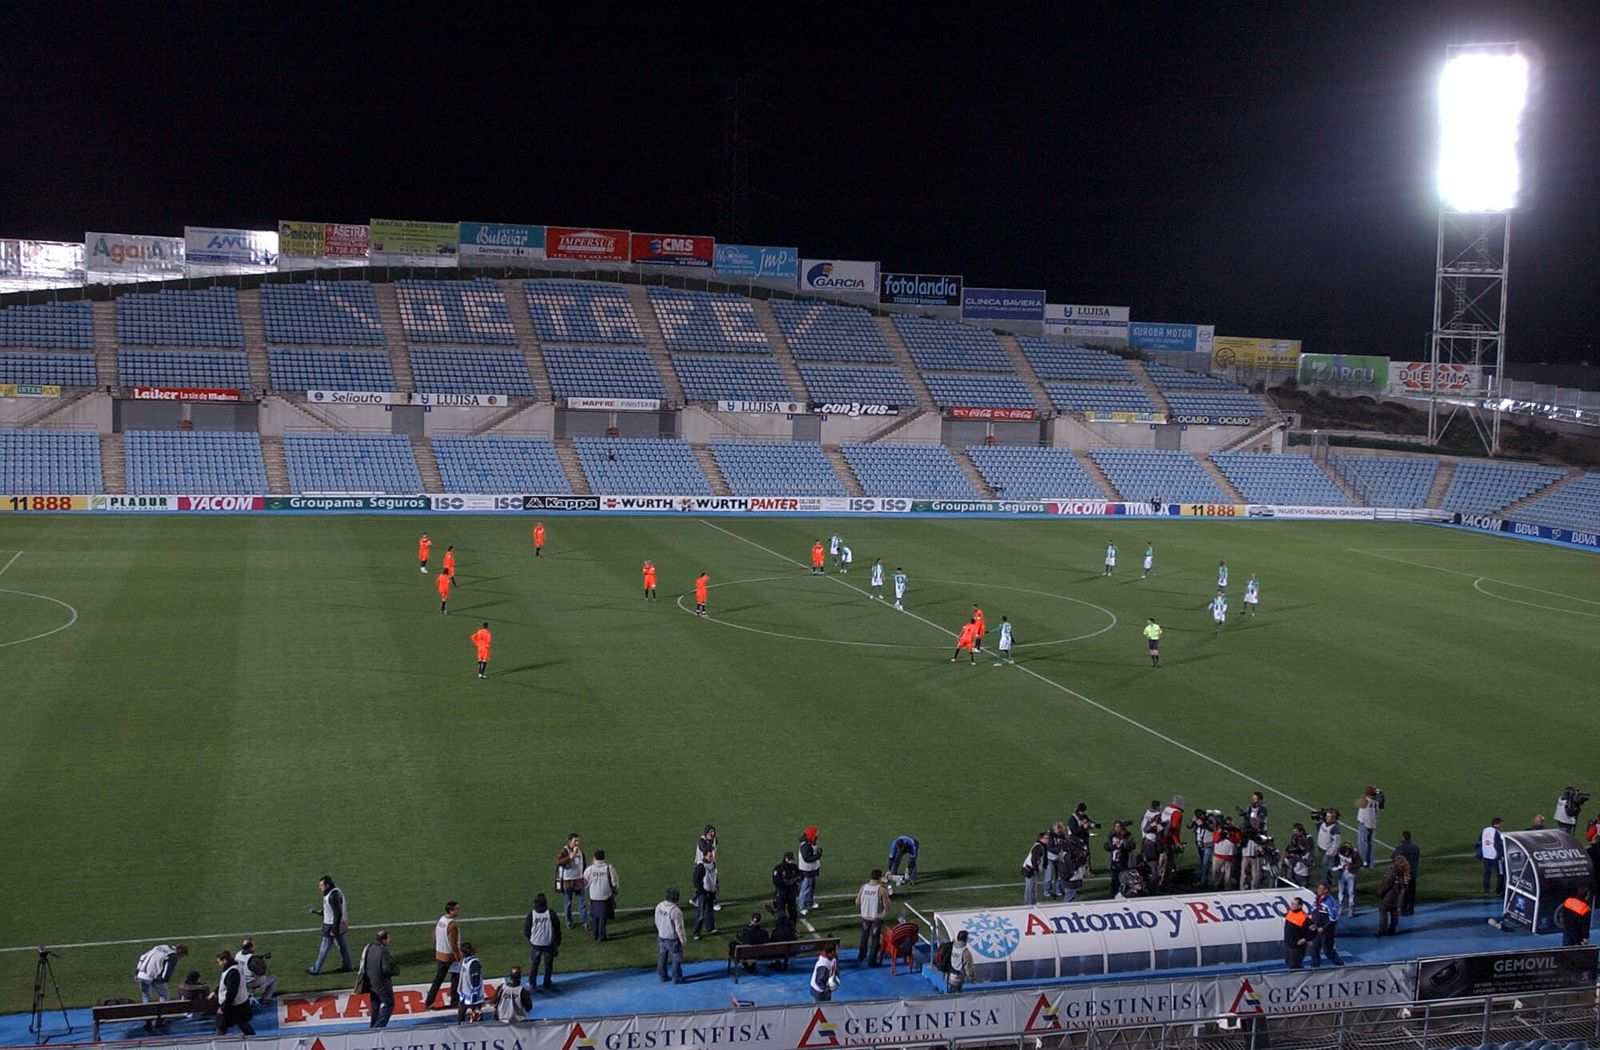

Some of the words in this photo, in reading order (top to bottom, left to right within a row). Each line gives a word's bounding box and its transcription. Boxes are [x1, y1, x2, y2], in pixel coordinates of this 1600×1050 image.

[476, 226, 528, 246] Bulevar
[560, 238, 615, 248] IMPERSUR
[662, 238, 693, 252] CMS
[816, 278, 865, 288] GARCIA
[885, 275, 957, 296] fotolandia
[965, 298, 1001, 306] CLINICA
[1003, 299, 1042, 307] BAVIERA
[1078, 307, 1110, 316] LUJISA
[1133, 326, 1164, 337] KUROBA
[1165, 328, 1193, 338] MOTOR
[1311, 361, 1375, 383] ZARCU
[134, 388, 178, 400] Laiker
[331, 391, 383, 404] Seliauto
[436, 394, 480, 406] LUJISA
[741, 401, 781, 413] LUJISA
[1178, 415, 1209, 424] OCASO
[1219, 416, 1250, 425] OCASO
[110, 497, 167, 507] PLADUR
[188, 497, 254, 510] YACOM
[290, 498, 363, 510] Groupama
[369, 498, 425, 509] Seguros
[435, 497, 464, 510] ISO
[494, 497, 523, 510] ISO
[545, 498, 598, 510] Kappa
[751, 498, 799, 510] PANTER
[849, 499, 875, 511] ISO
[881, 499, 906, 511] ISO
[932, 501, 992, 513] Groupama
[998, 501, 1044, 513] Seguros
[1056, 502, 1107, 516] YACOM
[1460, 514, 1503, 531] YACOM
[1515, 523, 1540, 537] BBVA
[1571, 532, 1597, 546] BBVA
[1533, 849, 1586, 861] GEMOVIL
[1024, 906, 1158, 936] Antonio
[1160, 909, 1183, 938] y
[1494, 957, 1558, 972] GEMOVIL
[1268, 979, 1403, 1004] GESTINFISA
[1066, 993, 1208, 1019] GESTINFISA
[845, 1009, 999, 1035] GESTINFISA
[605, 1024, 770, 1050] GESTINFISA
